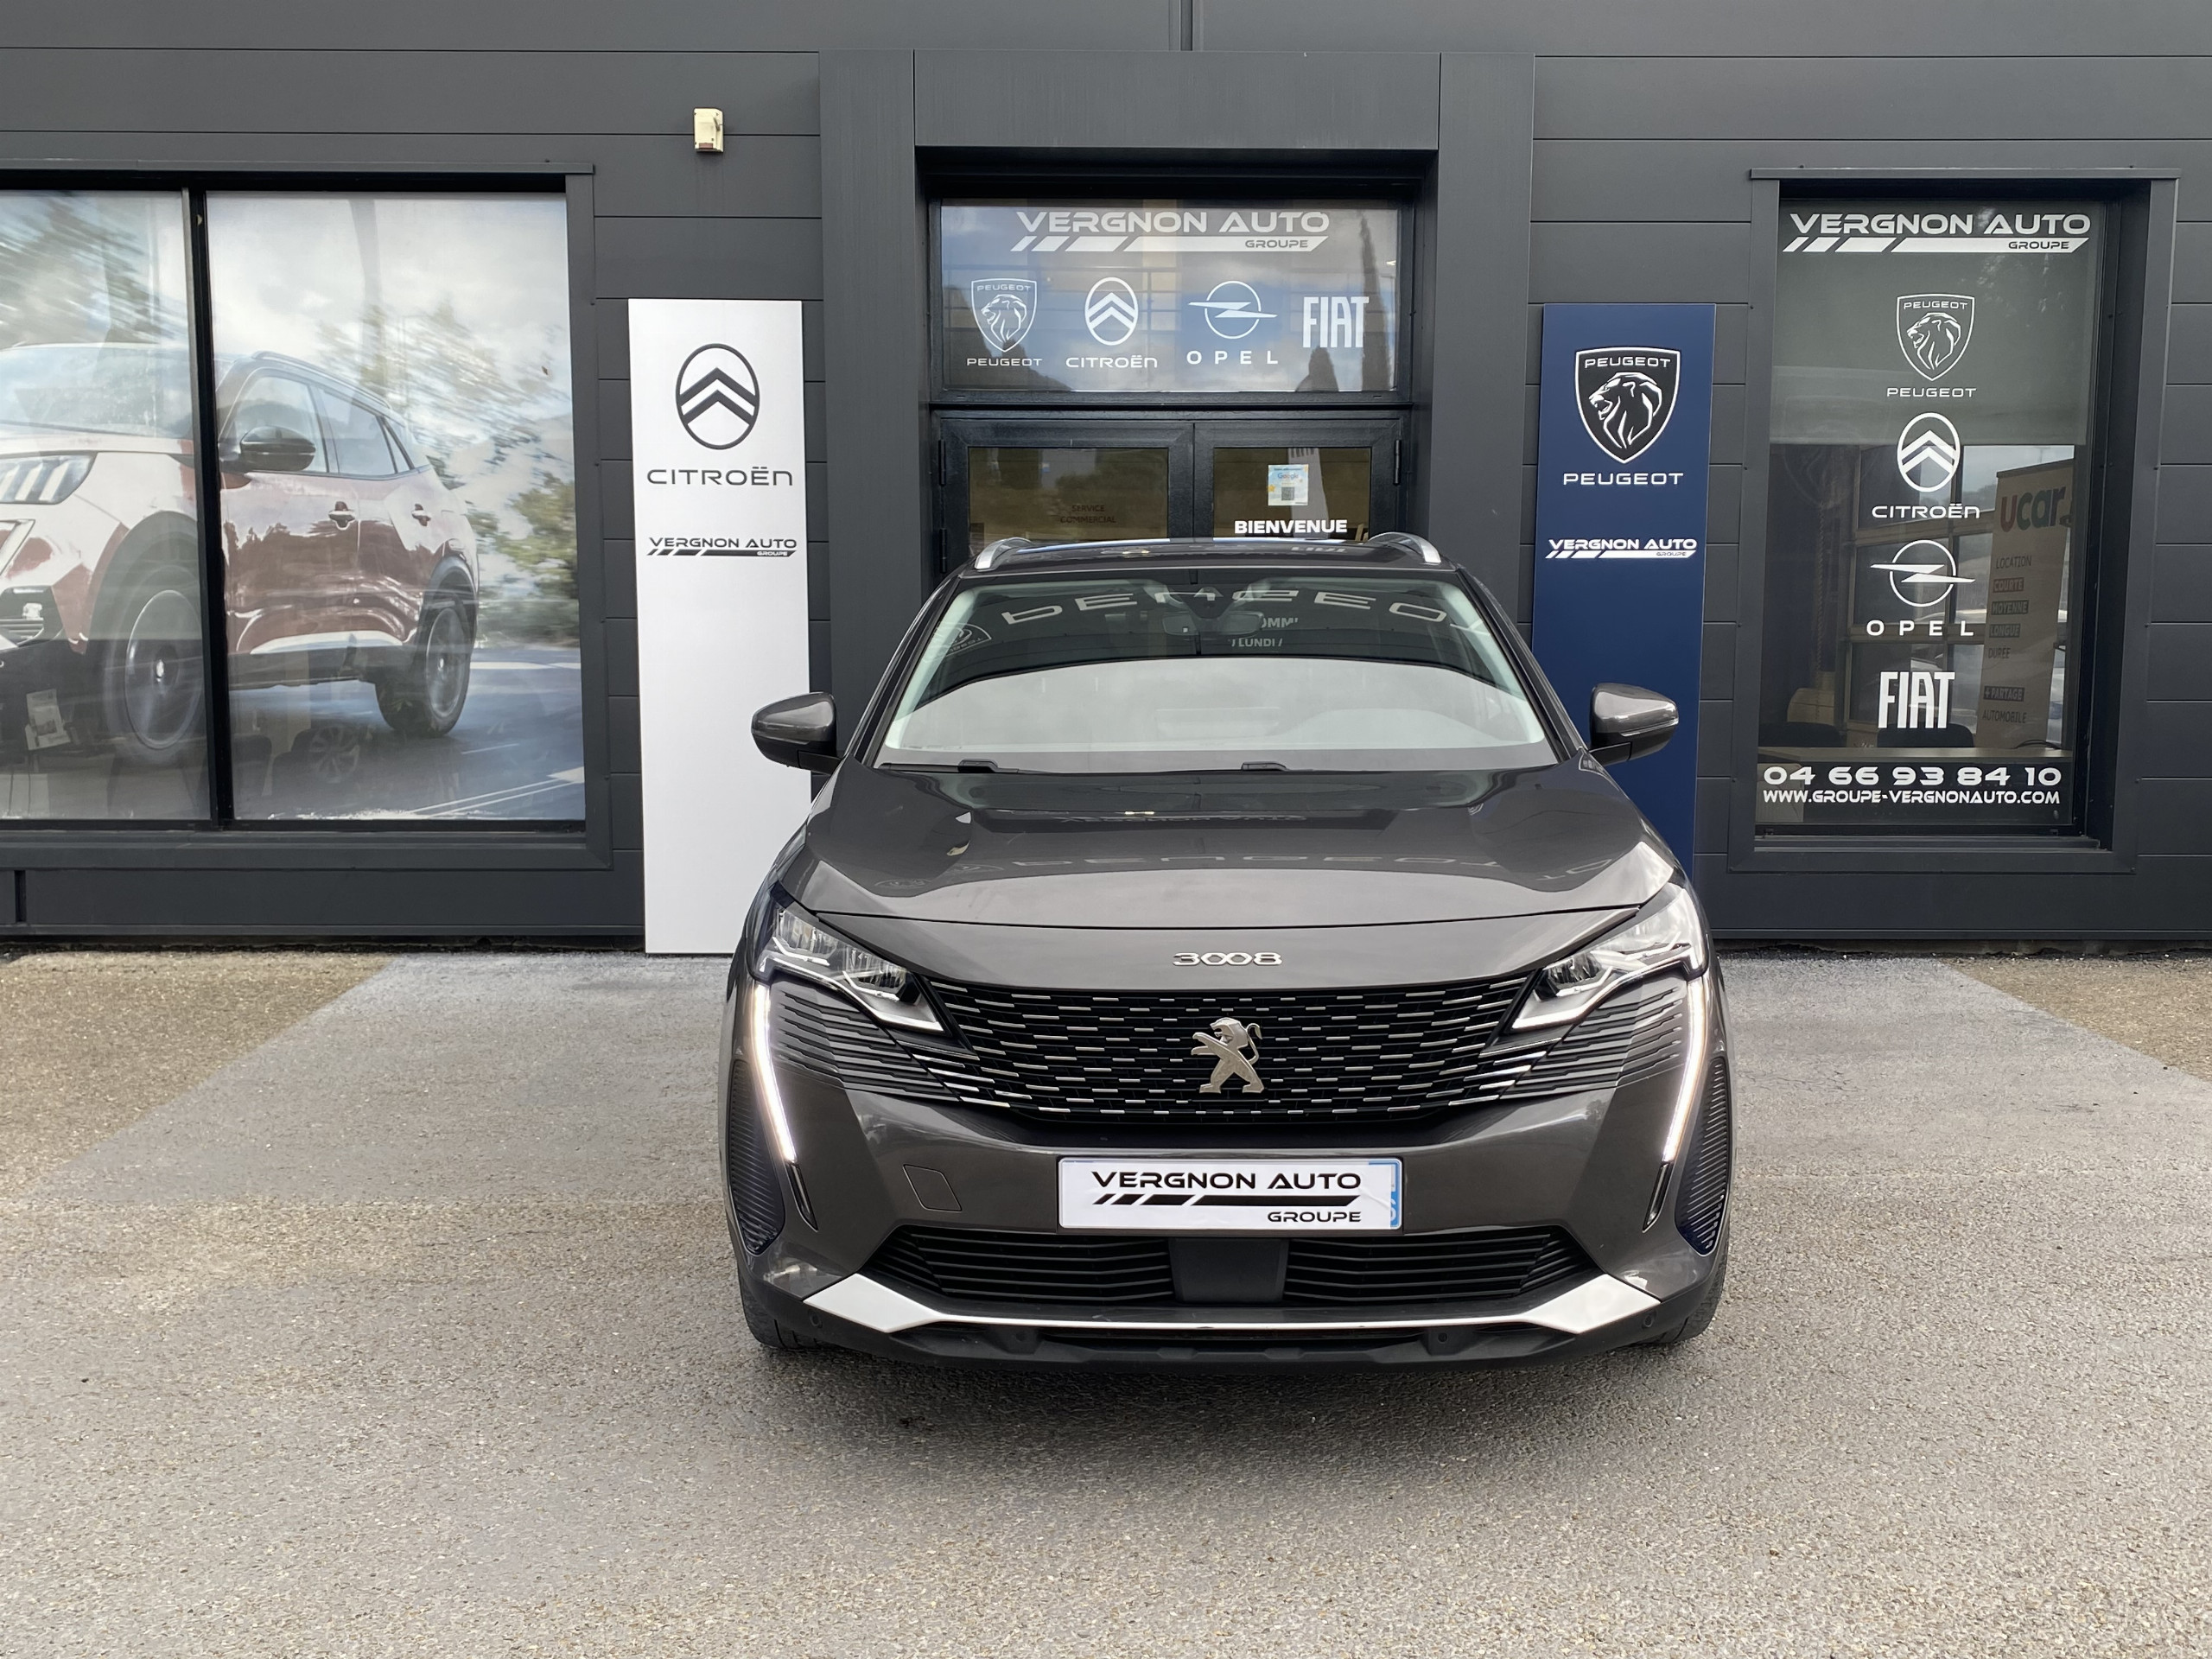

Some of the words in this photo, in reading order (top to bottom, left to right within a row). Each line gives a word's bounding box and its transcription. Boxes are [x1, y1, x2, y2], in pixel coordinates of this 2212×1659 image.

[1016, 212, 1207, 233] VERGNON
[1218, 212, 1330, 232] AUTO
[1790, 213, 1972, 234] VERGNON
[1984, 213, 2091, 234] AUTO
[1245, 240, 1308, 249] GROUPE
[2008, 241, 2069, 250] GROUPE
[976, 283, 1032, 292] PEUGEOT
[1904, 301, 1968, 310] PEUGEOT
[1302, 296, 1370, 348] FIAT
[967, 358, 1044, 367] PEUGEOT
[1186, 350, 1279, 365] OPEL
[1585, 356, 1671, 368] PEUGEOT
[1887, 387, 1977, 397] PEUGEOT
[1563, 473, 1684, 486] PEUGEOT
[1234, 519, 1348, 534] BIENVENUE
[649, 537, 740, 548] VERGNON
[745, 538, 797, 549] AUTO
[1548, 538, 1641, 550] VERGNON
[1643, 538, 1698, 550] AUTO
[1991, 601, 2029, 615] MOYENNE
[1866, 620, 1974, 637] OPEL
[1989, 624, 2020, 638] LONGUE
[1878, 671, 1955, 729] FIAT
[1982, 710, 2028, 724] AUTOMOBILE
[1764, 766, 1815, 785] 04
[1828, 766, 1879, 785] 66
[1892, 766, 1945, 785] 93
[1956, 766, 2011, 786] 84
[2024, 766, 2062, 786] 10
[1763, 790, 2061, 804] WWW.GROUPE-VERGNONAUTO.COM
[1173, 951, 1284, 966] 3008
[1091, 1171, 1256, 1190] VERGNON
[1268, 1171, 1362, 1190] AUTO
[1267, 1211, 1362, 1223] GROUPE
